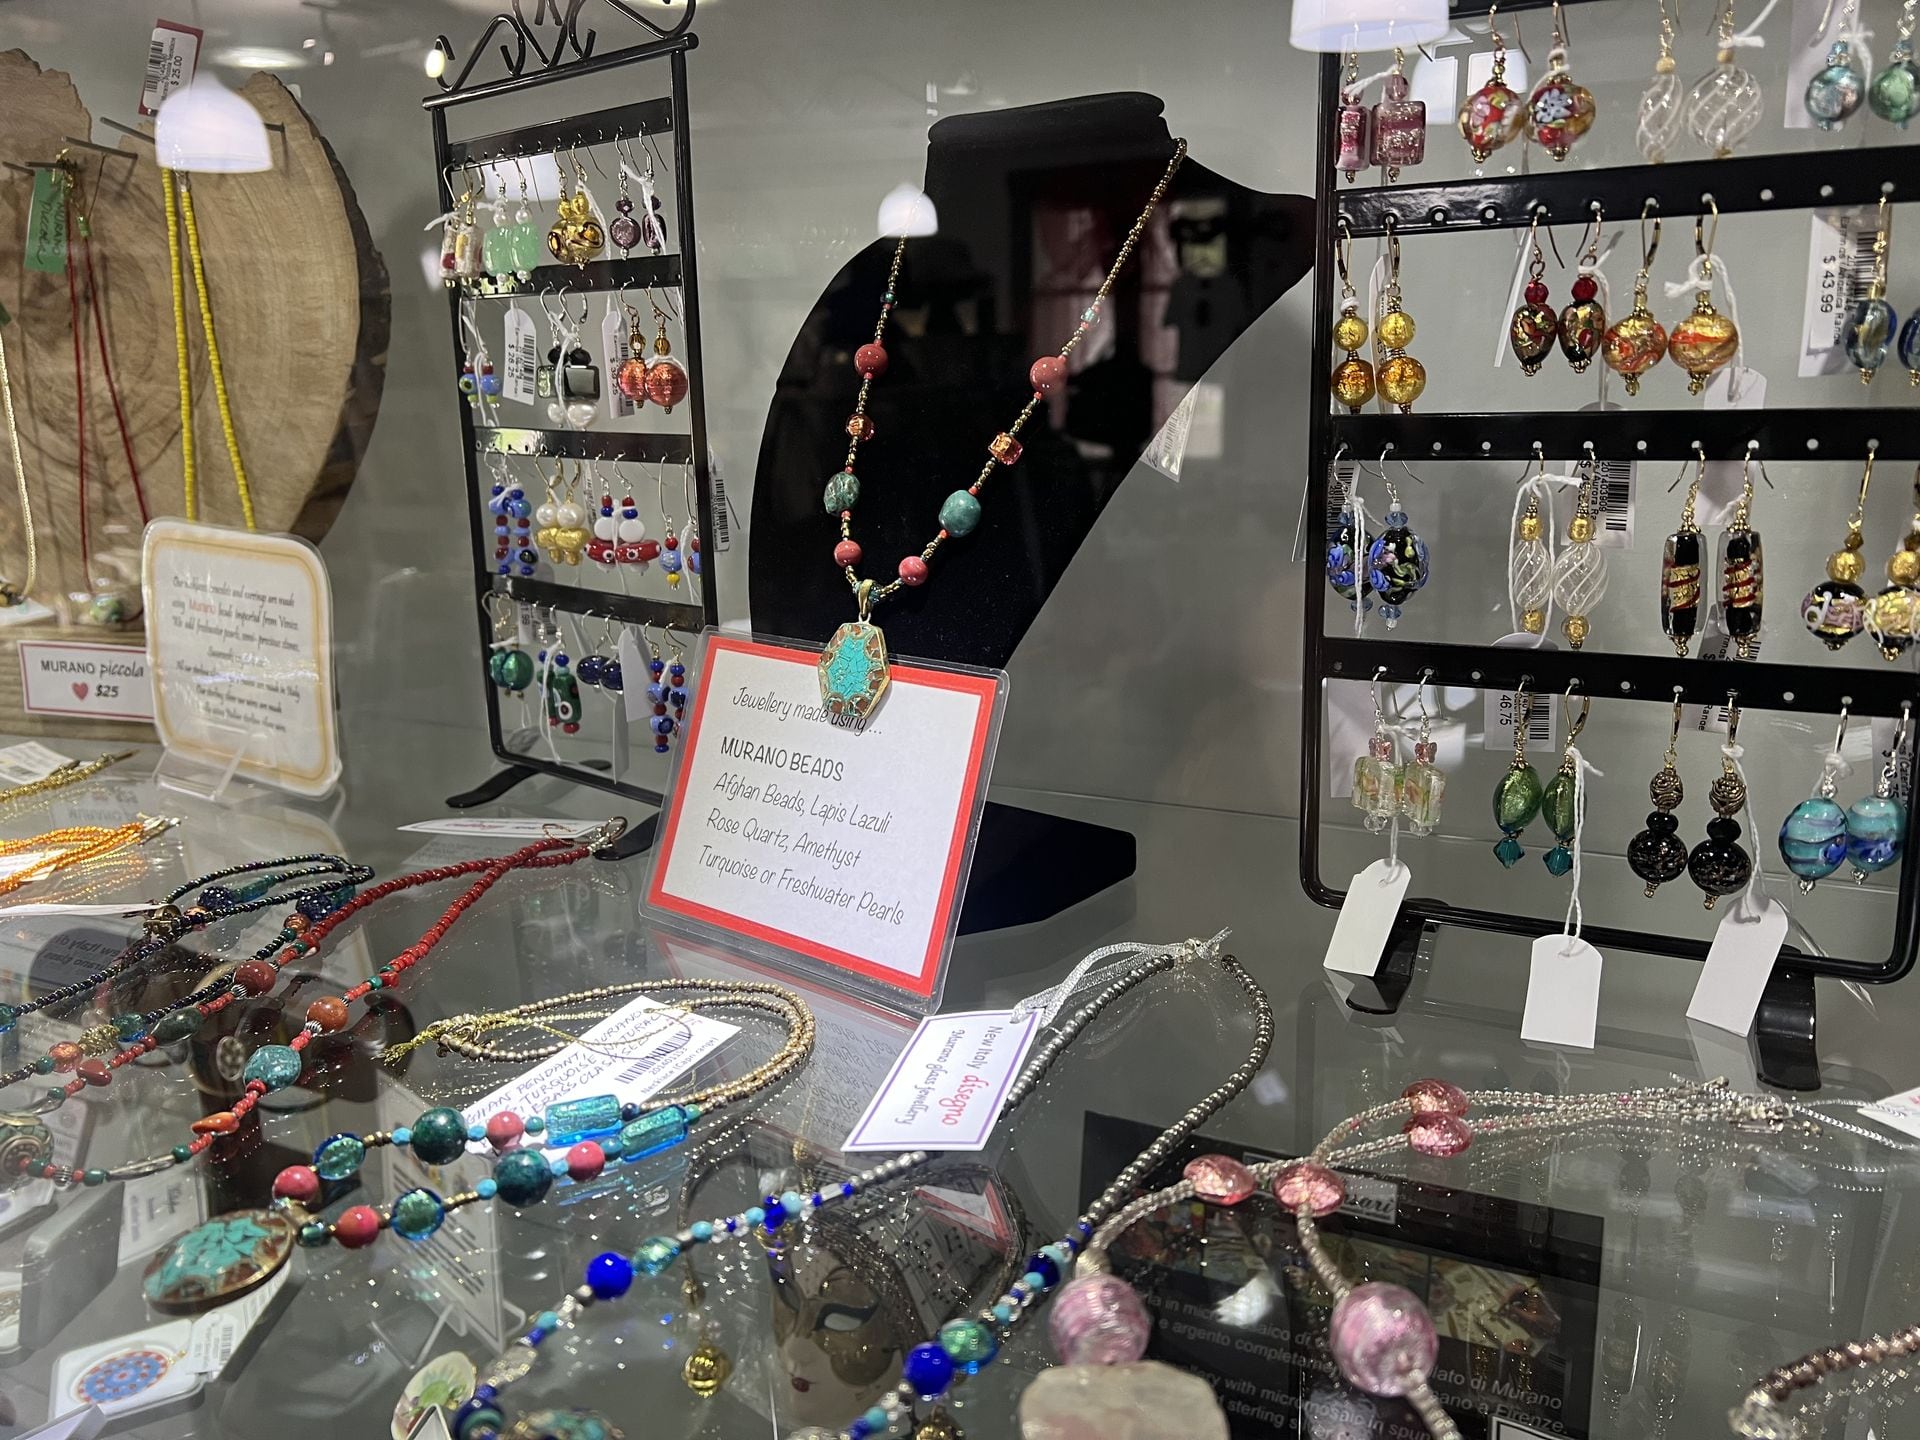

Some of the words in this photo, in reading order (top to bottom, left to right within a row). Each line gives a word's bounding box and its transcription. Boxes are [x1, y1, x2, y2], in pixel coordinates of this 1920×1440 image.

[173, 56, 183, 79] 25.00
[1820, 271, 1836, 313] 43.99
[1599, 462, 1610, 512] 201403909
[41, 660, 95, 674] MURANO
[100, 661, 144, 681] piccola
[95, 684, 119, 698] $25
[733, 686, 790, 722] Jewellery
[793, 703, 828, 724] made
[1500, 694, 1512, 725] 46.75
[721, 736, 787, 769] MURANO
[790, 753, 844, 782] BEADS
[713, 772, 760, 803] Afghan
[762, 784, 805, 816] Beads,
[810, 795, 847, 824] Lapis
[849, 804, 893, 834] Lazuli
[706, 808, 740, 834] Rose
[743, 818, 789, 851] Quartz,
[792, 833, 861, 874] Amethyst
[699, 845, 758, 881] Turquoise
[760, 868, 776, 885] or
[777, 869, 855, 911] Freshwater
[857, 892, 905, 926] Pearls
[941, 1029, 965, 1062] Murano
[982, 1025, 1003, 1047] New
[967, 1047, 993, 1069] Italy
[939, 1074, 989, 1125] disegno
[1172, 1322, 1231, 1347] argento
[1225, 1377, 1256, 1396] with
[1491, 1380, 1563, 1410] Murano
[1228, 1399, 1284, 1429] sterling
